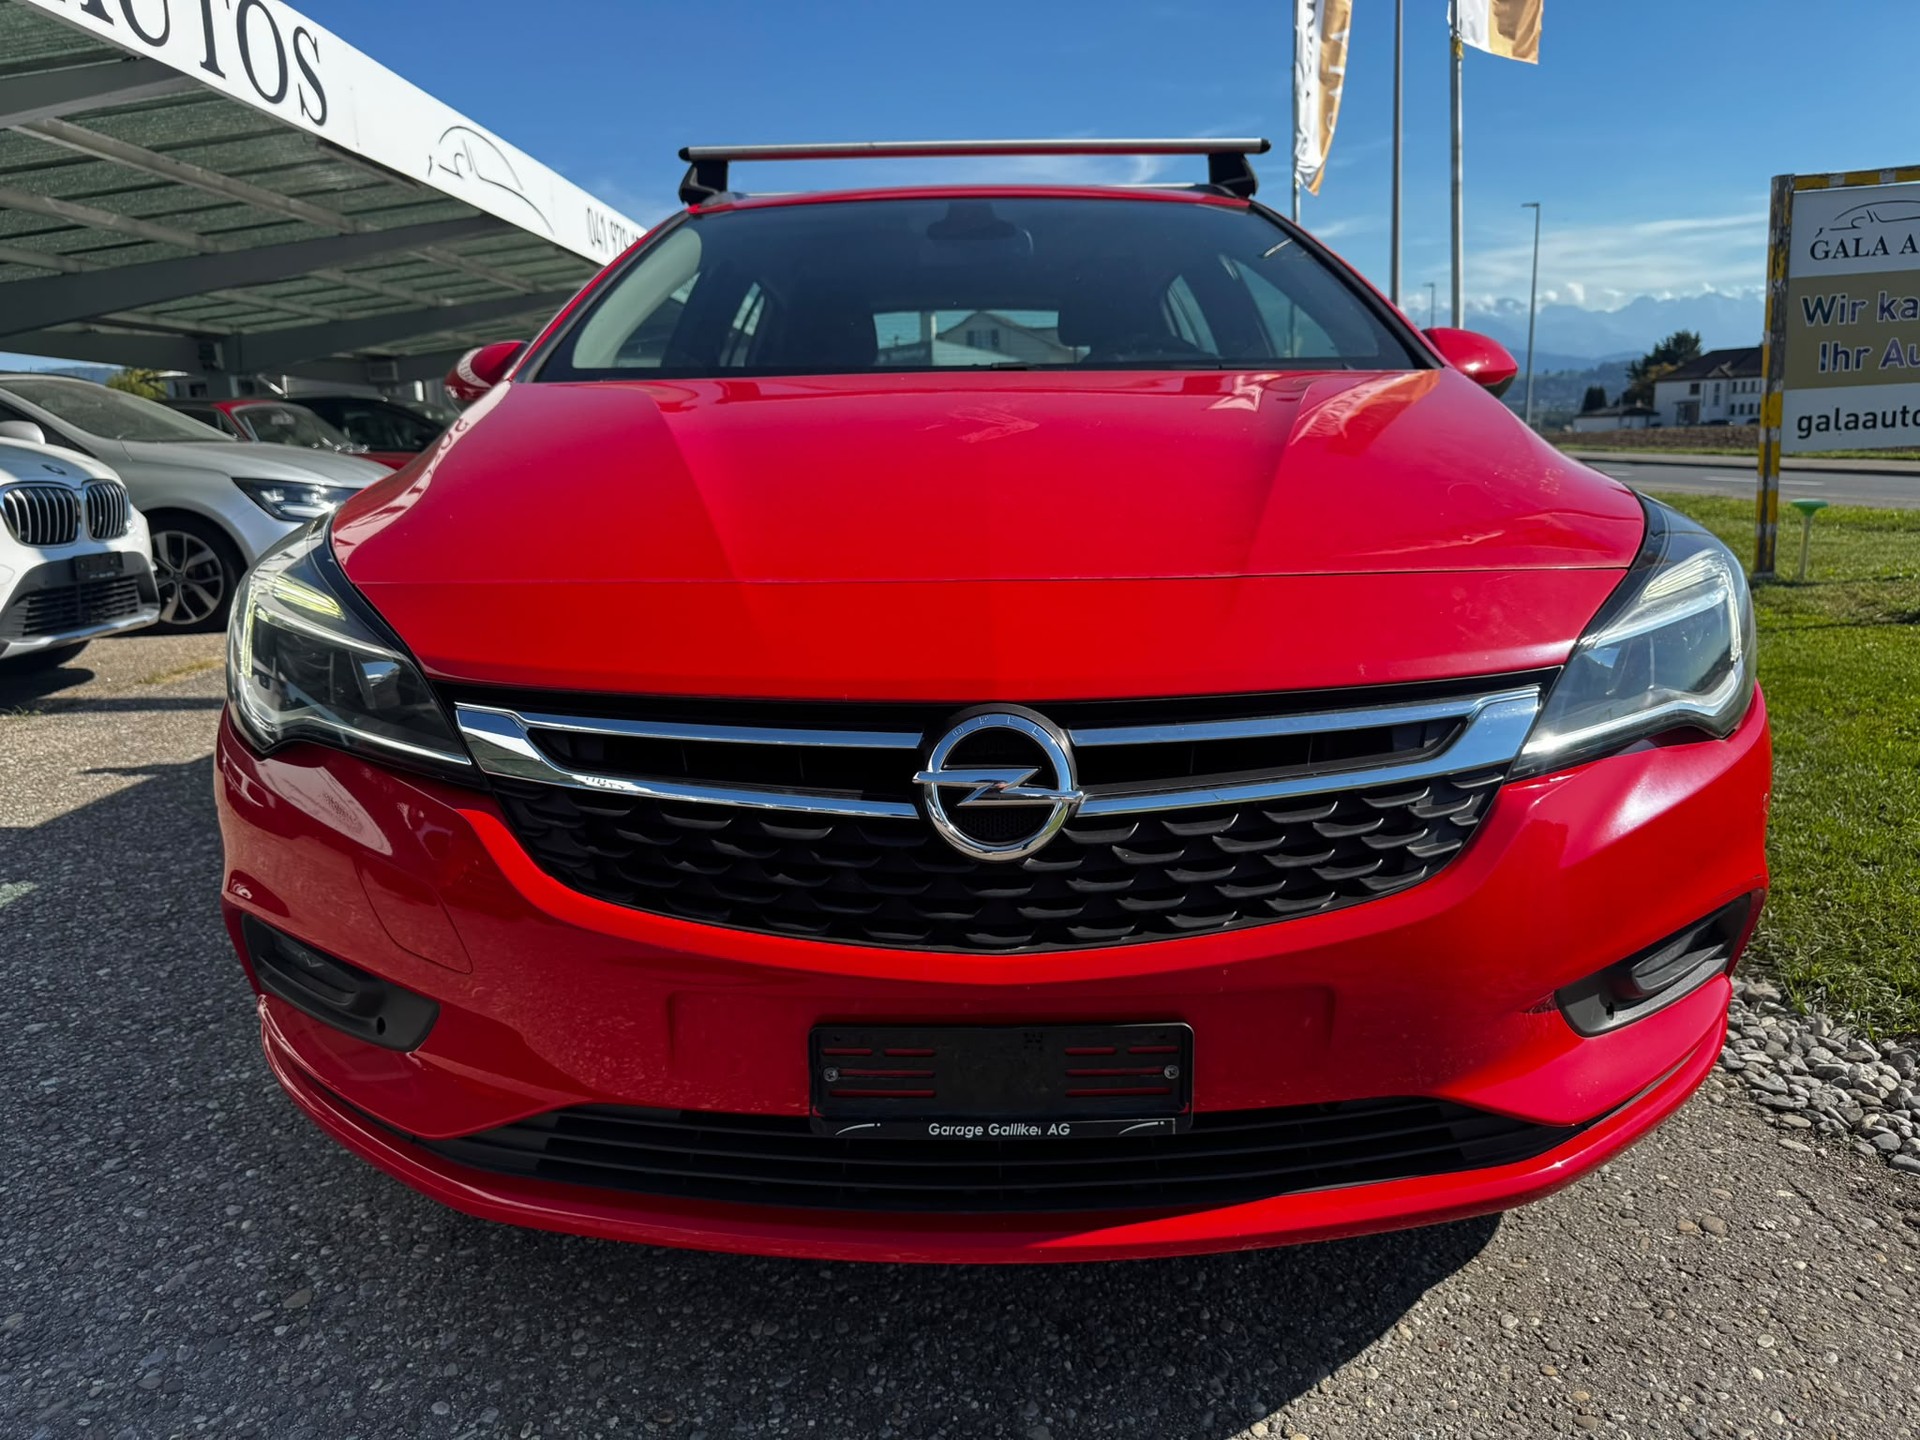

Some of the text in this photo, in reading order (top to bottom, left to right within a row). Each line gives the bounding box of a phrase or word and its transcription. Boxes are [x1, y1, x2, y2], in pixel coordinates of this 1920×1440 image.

[1809, 235, 1890, 261] GALA
[1801, 290, 1920, 327] Wir ka
[1819, 341, 1873, 373] Ihr
[928, 1123, 984, 1139] Garage
[1047, 1123, 1071, 1136] AG
